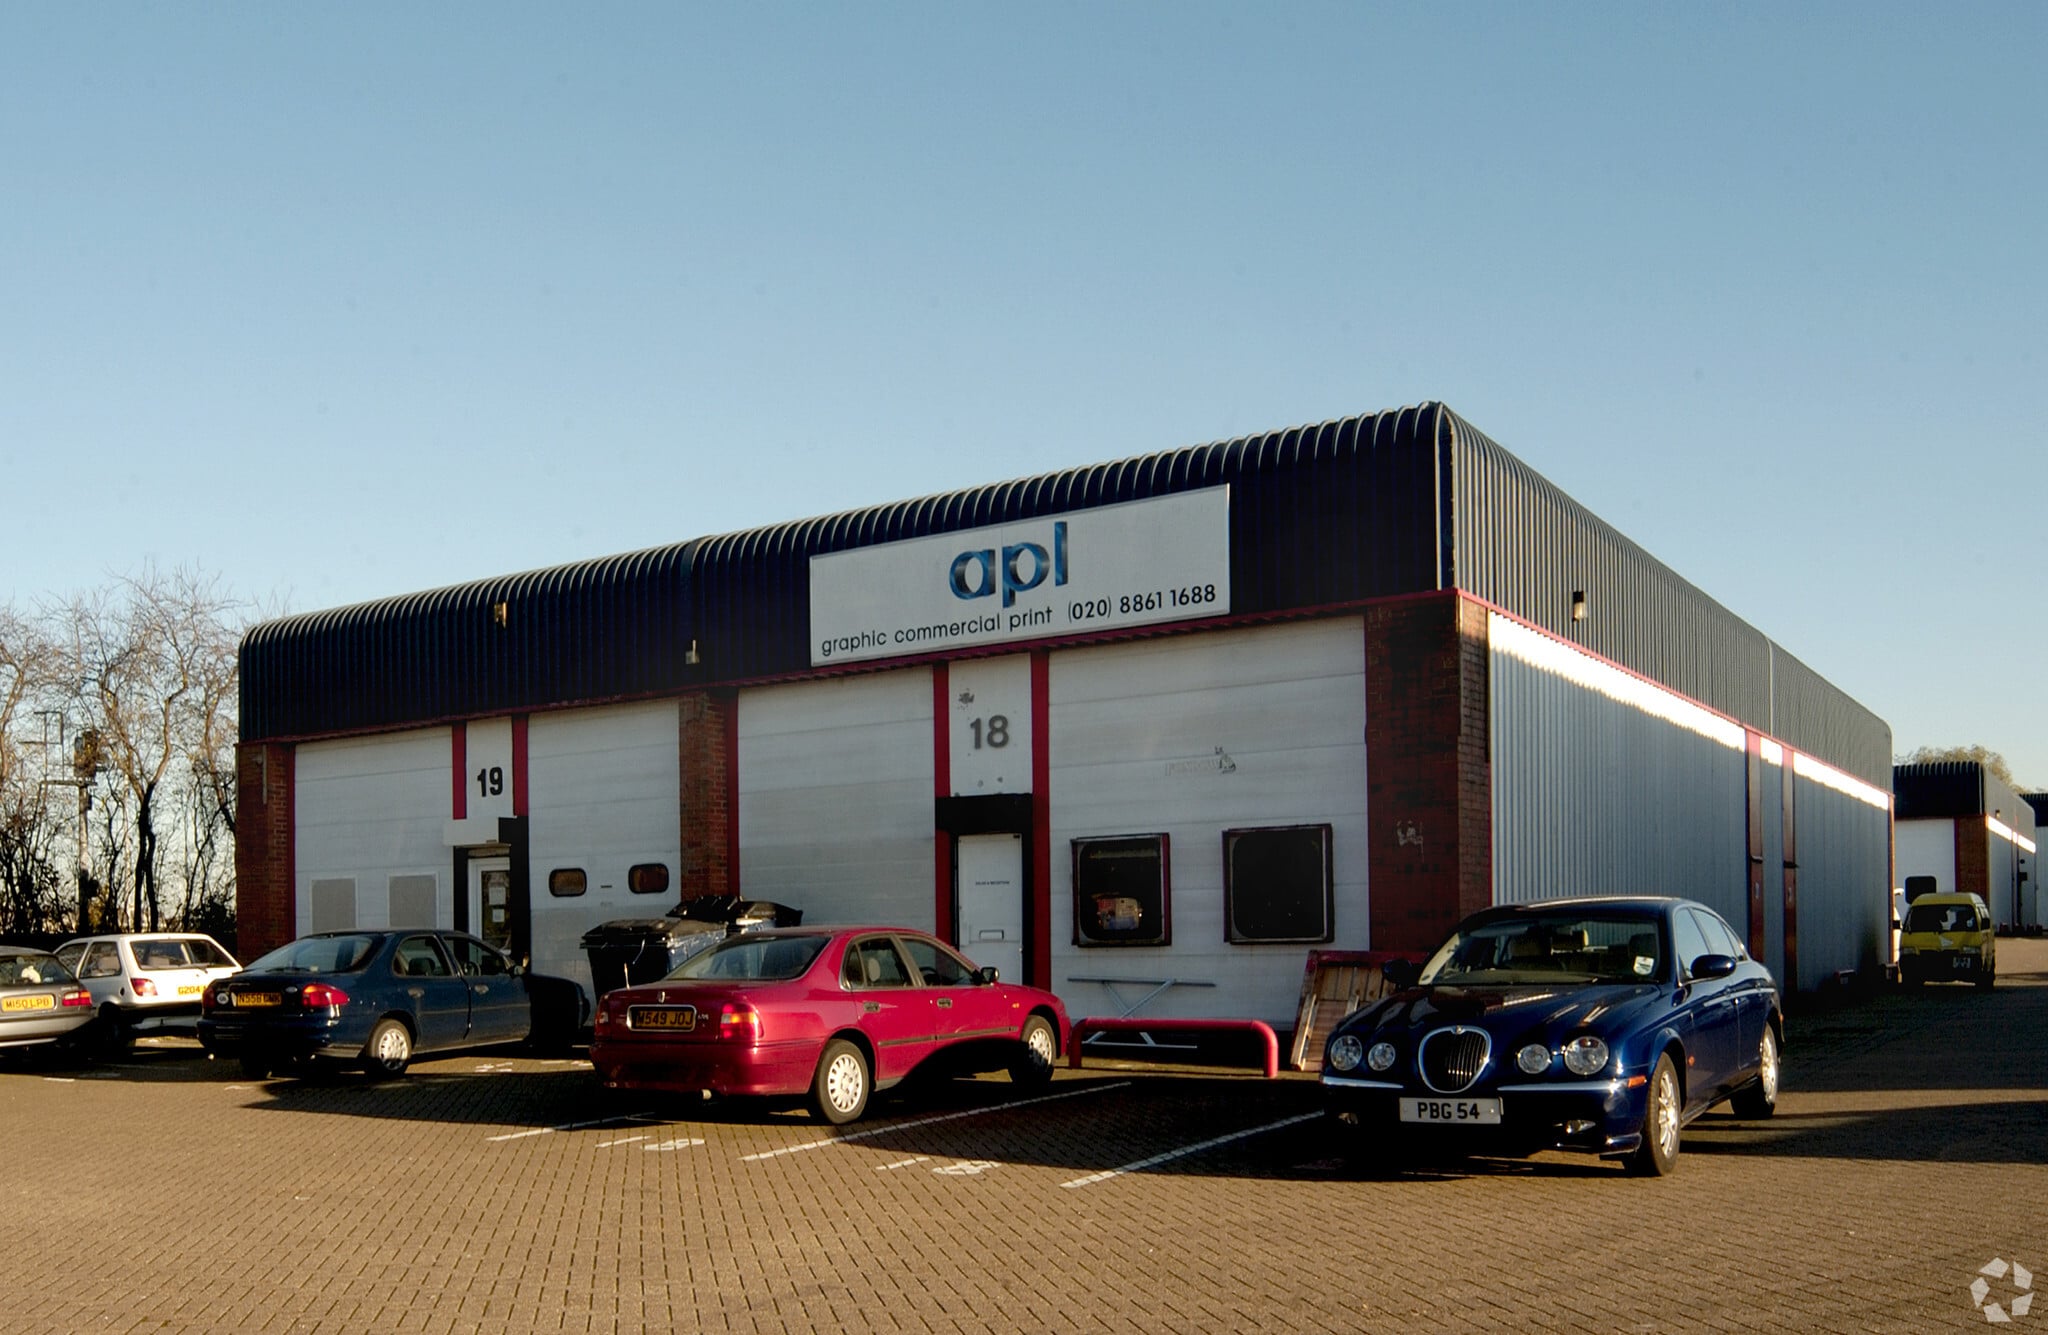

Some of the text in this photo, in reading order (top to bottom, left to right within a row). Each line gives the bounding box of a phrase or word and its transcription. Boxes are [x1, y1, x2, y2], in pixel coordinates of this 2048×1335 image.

[949, 521, 1068, 608] apl
[822, 584, 1216, 656] graphic commercial print (020) 8861 1688
[969, 714, 1010, 749] 18
[477, 766, 504, 797] 19
[1417, 1102, 1480, 1119] PBG 54
